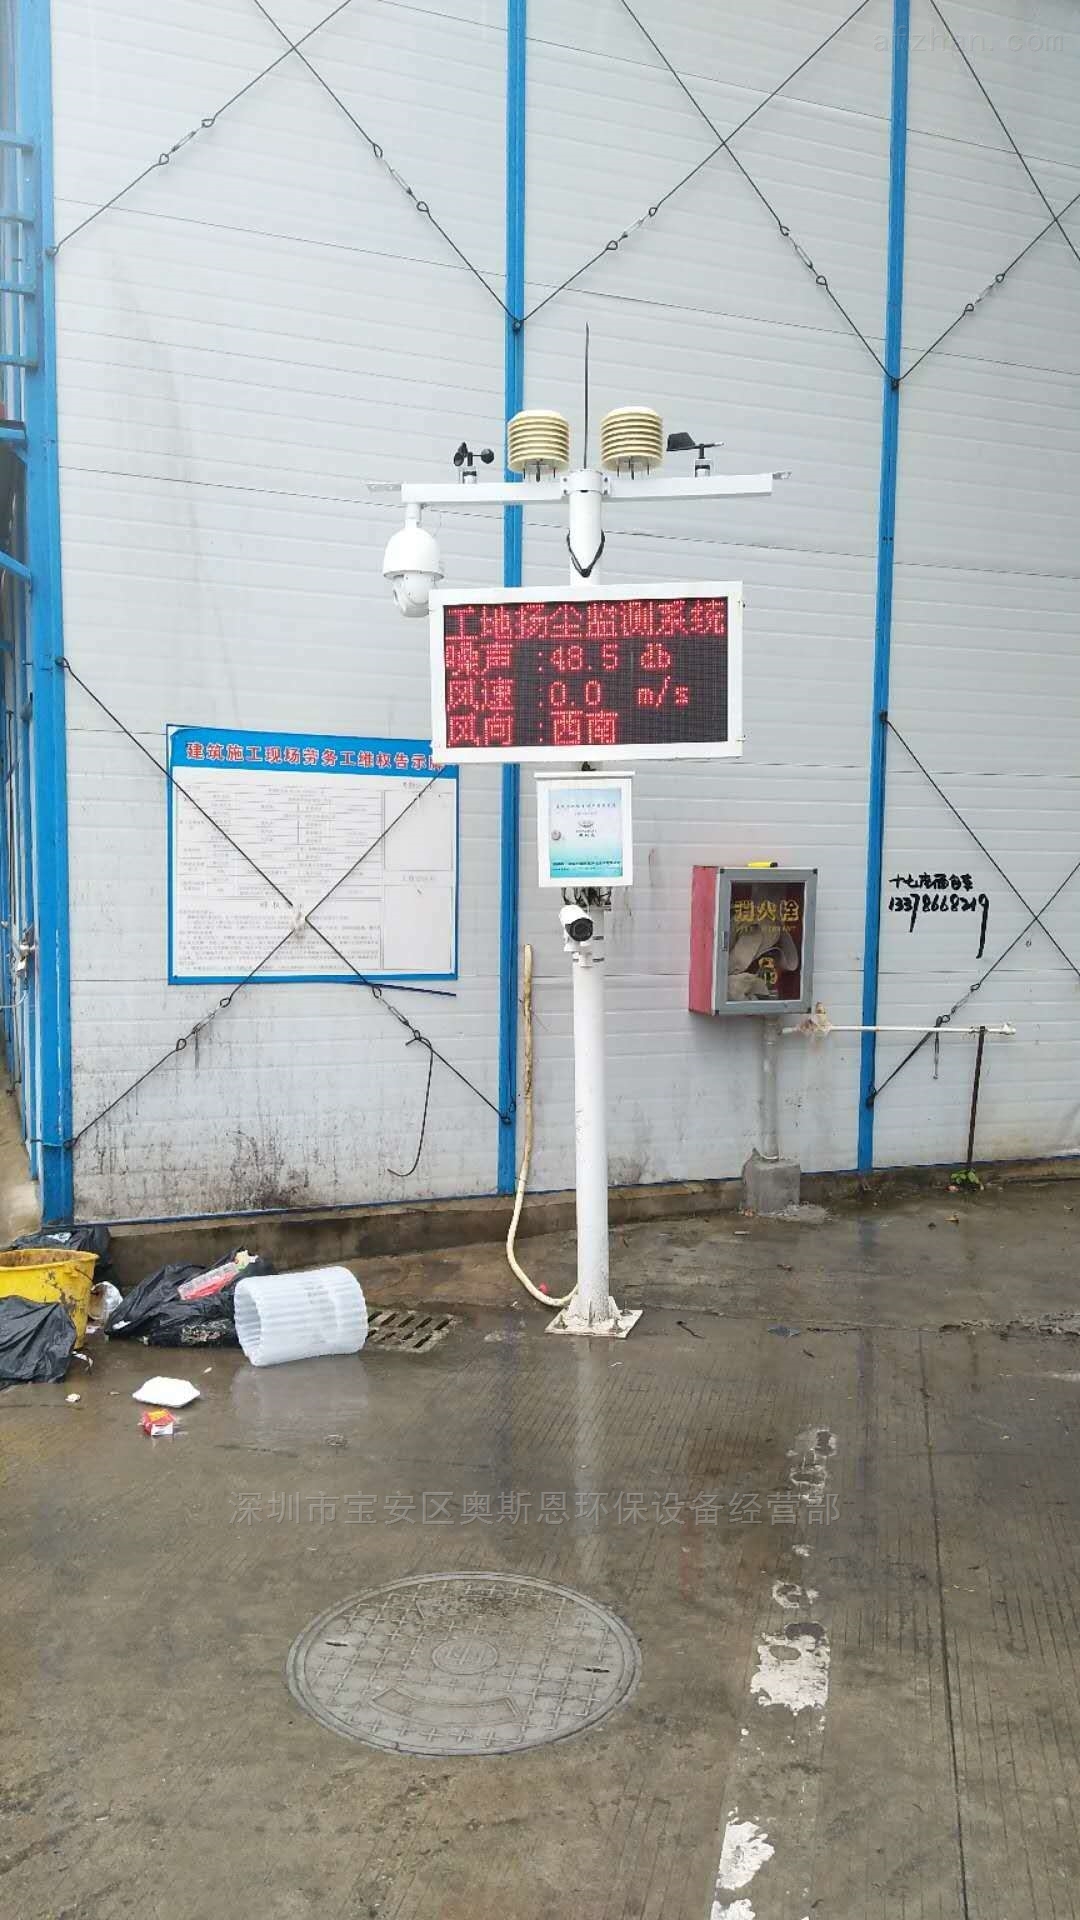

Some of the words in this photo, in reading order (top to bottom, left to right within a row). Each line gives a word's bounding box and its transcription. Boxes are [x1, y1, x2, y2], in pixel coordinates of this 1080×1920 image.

[445, 599, 725, 640] 工地扬尘监测系统
[447, 677, 513, 711] 风速
[637, 675, 689, 707] m/s
[447, 712, 513, 746] 风向
